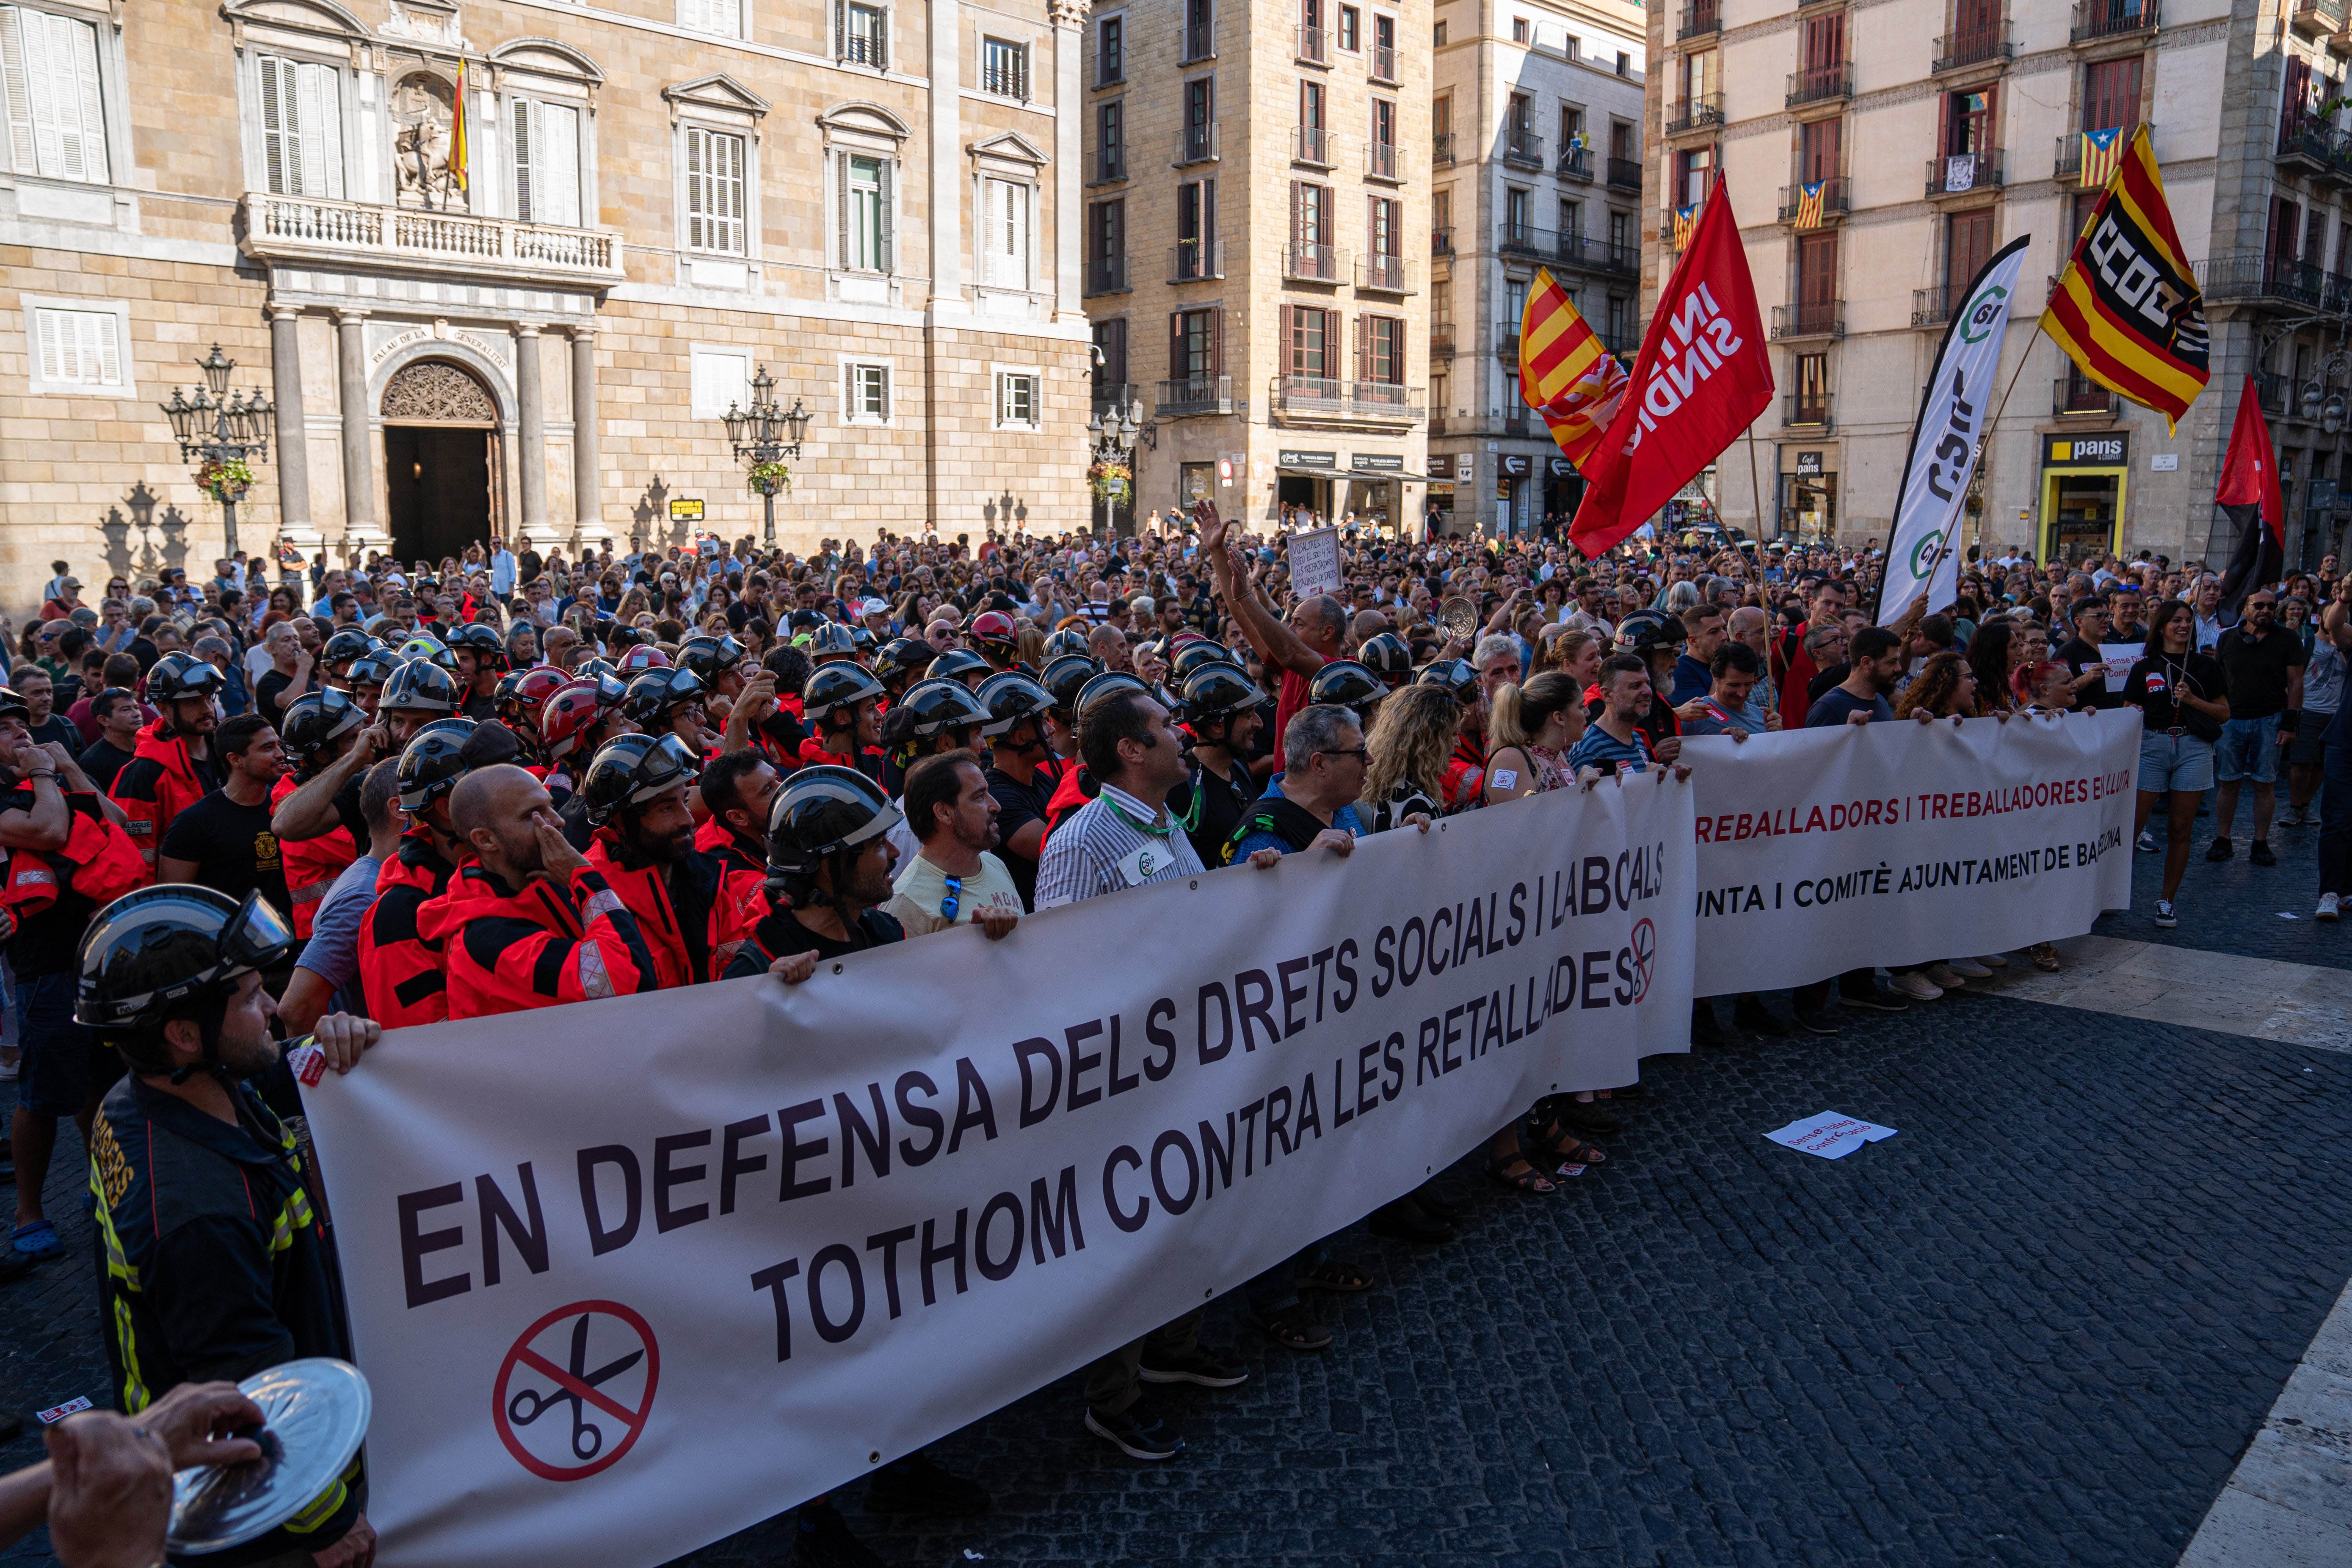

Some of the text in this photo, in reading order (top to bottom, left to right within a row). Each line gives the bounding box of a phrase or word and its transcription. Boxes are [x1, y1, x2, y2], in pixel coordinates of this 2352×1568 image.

[2090, 211, 2183, 328] CCOO
[2074, 440, 2122, 460] pans
[1798, 464, 1819, 475] pans
[878, 660, 896, 674] ALVARO
[2106, 656, 2131, 666] Sense
[433, 783, 445, 791] MSA
[1906, 796, 1911, 822] I
[1918, 779, 2088, 820] TREBALLADORES
[2093, 775, 2105, 800] EN
[2106, 768, 2129, 795] LLUITA
[822, 846, 836, 854] MSA
[1775, 882, 1782, 909] I
[1793, 860, 1892, 908] COMITÈ
[1897, 849, 2040, 893] AJUNTAMENT
[2044, 845, 2070, 872] DE
[167, 987, 188, 999] MSA
[397, 1160, 549, 1310] EN
[577, 1056, 998, 1257] DEFENSA
[1012, 997, 1176, 1129] DELS
[1197, 937, 1359, 1066] DRETS
[1371, 882, 1527, 998] SOCIALS
[1535, 875, 1544, 937] I
[1787, 1128, 1822, 1145] Sense
[750, 946, 1633, 1363] TOTHOM CONTRA LES RETALLADES
